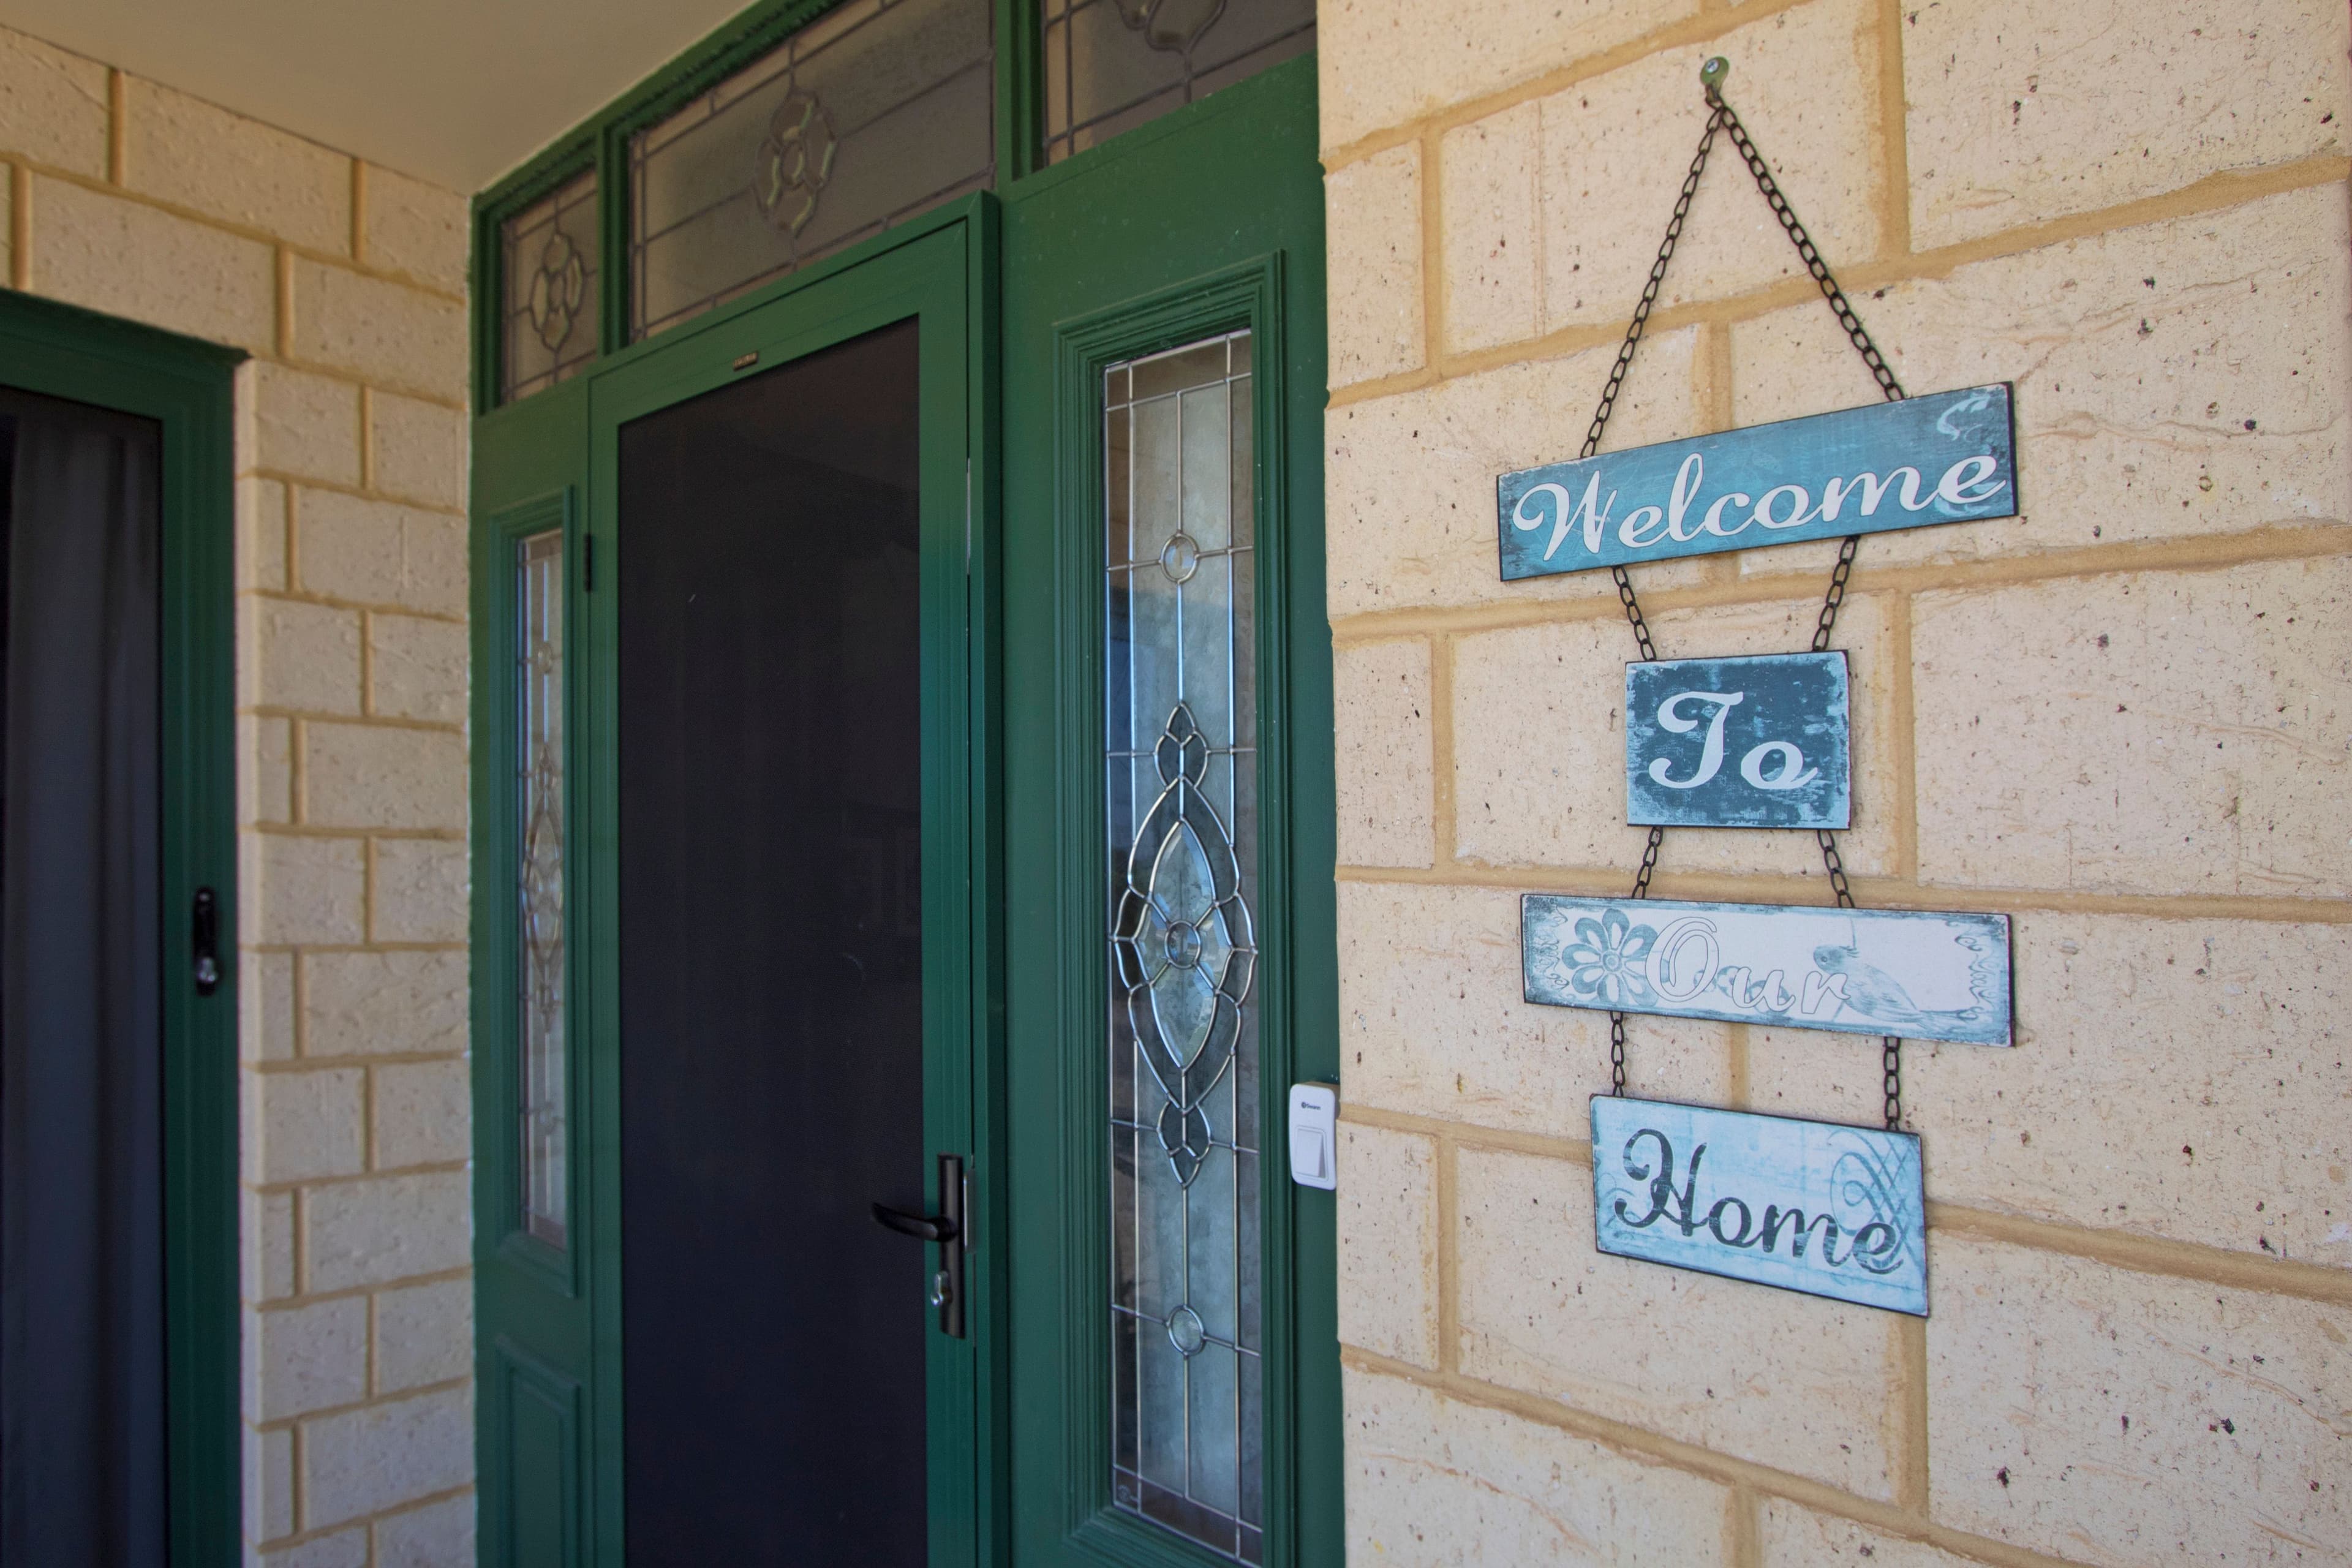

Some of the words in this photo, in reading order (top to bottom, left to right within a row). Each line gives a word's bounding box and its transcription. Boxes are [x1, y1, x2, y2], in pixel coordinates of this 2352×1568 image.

[1512, 453, 2007, 561] Welcome
[1649, 691, 1818, 790] To
[1645, 916, 1851, 1014] Our
[1615, 1128, 1904, 1275] Home
